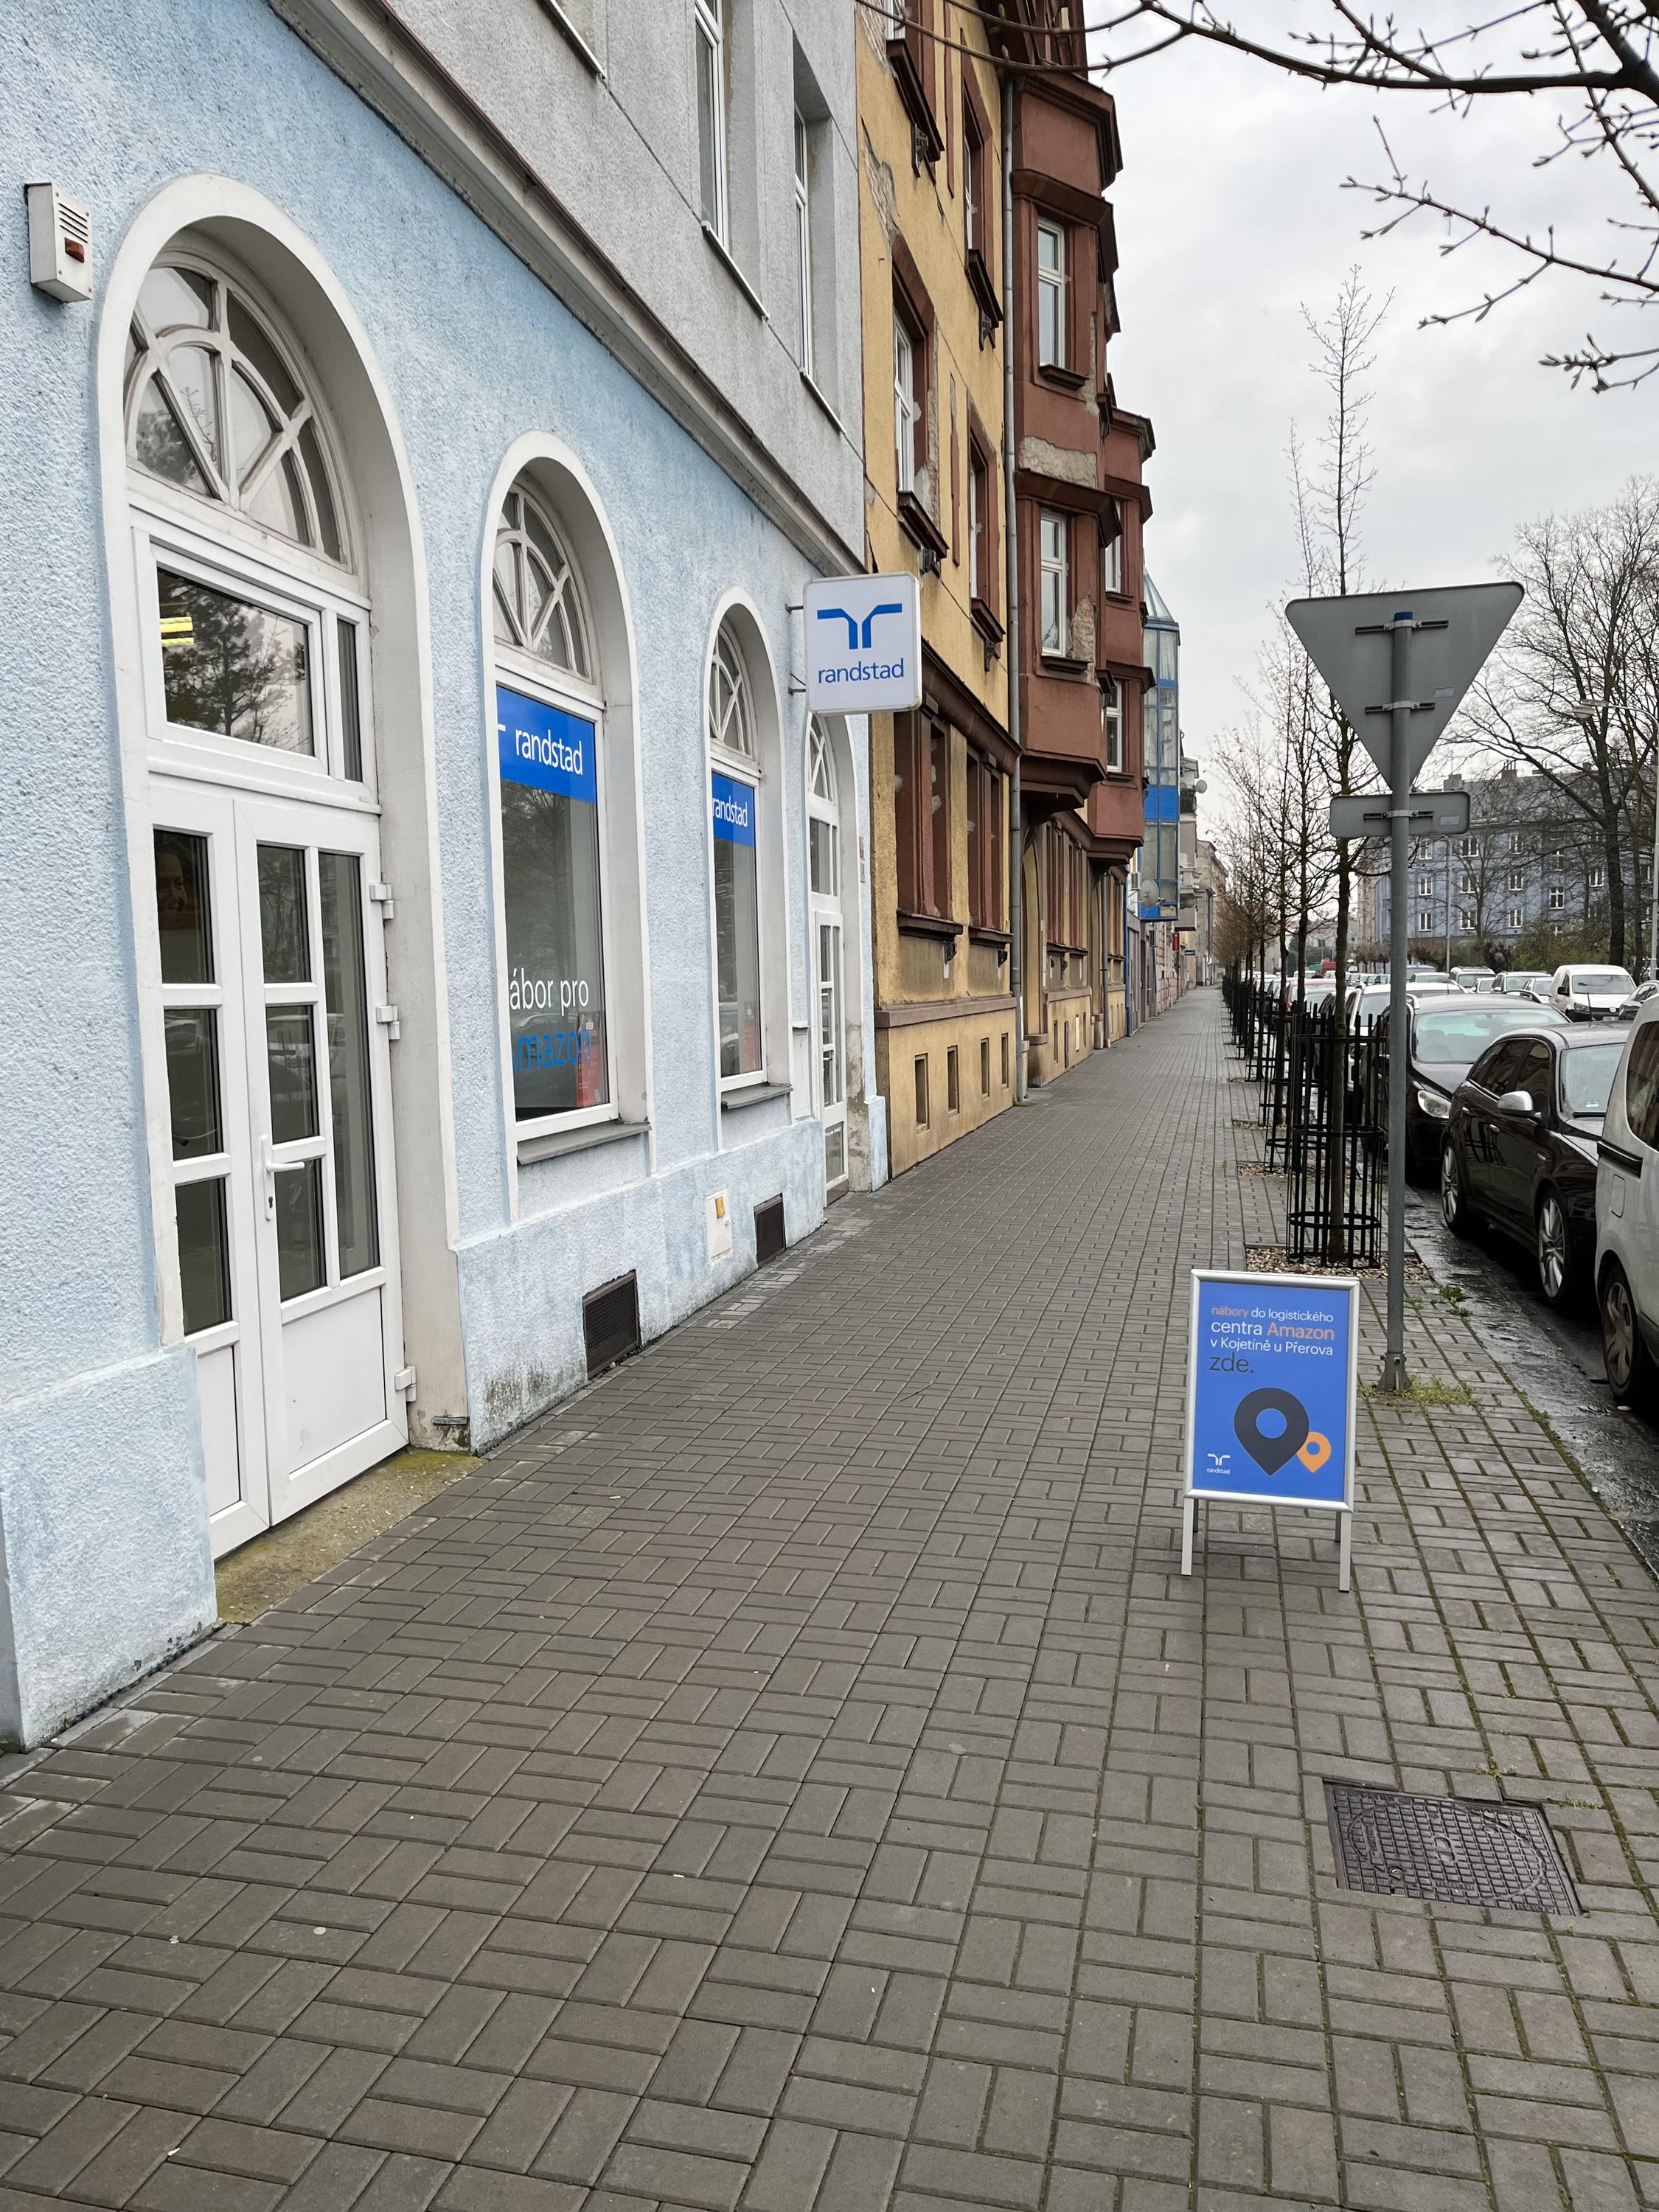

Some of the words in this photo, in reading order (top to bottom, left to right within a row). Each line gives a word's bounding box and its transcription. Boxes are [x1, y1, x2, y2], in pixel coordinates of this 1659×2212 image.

[818, 657, 904, 684] randstad
[515, 729, 582, 775] randstad
[712, 795, 748, 827] randstad
[560, 979, 589, 1016] pro
[512, 1030, 593, 1074] mazon
[1251, 1307, 1266, 1318] do
[1268, 1308, 1334, 1323] logistického
[1211, 1321, 1262, 1336] centra
[1267, 1322, 1335, 1340] Amazon
[1210, 1340, 1217, 1348] v
[1221, 1338, 1271, 1352] Kojetíně
[1274, 1343, 1281, 1352] u
[1285, 1342, 1333, 1356] Přerova
[1209, 1352, 1254, 1374] zde.
